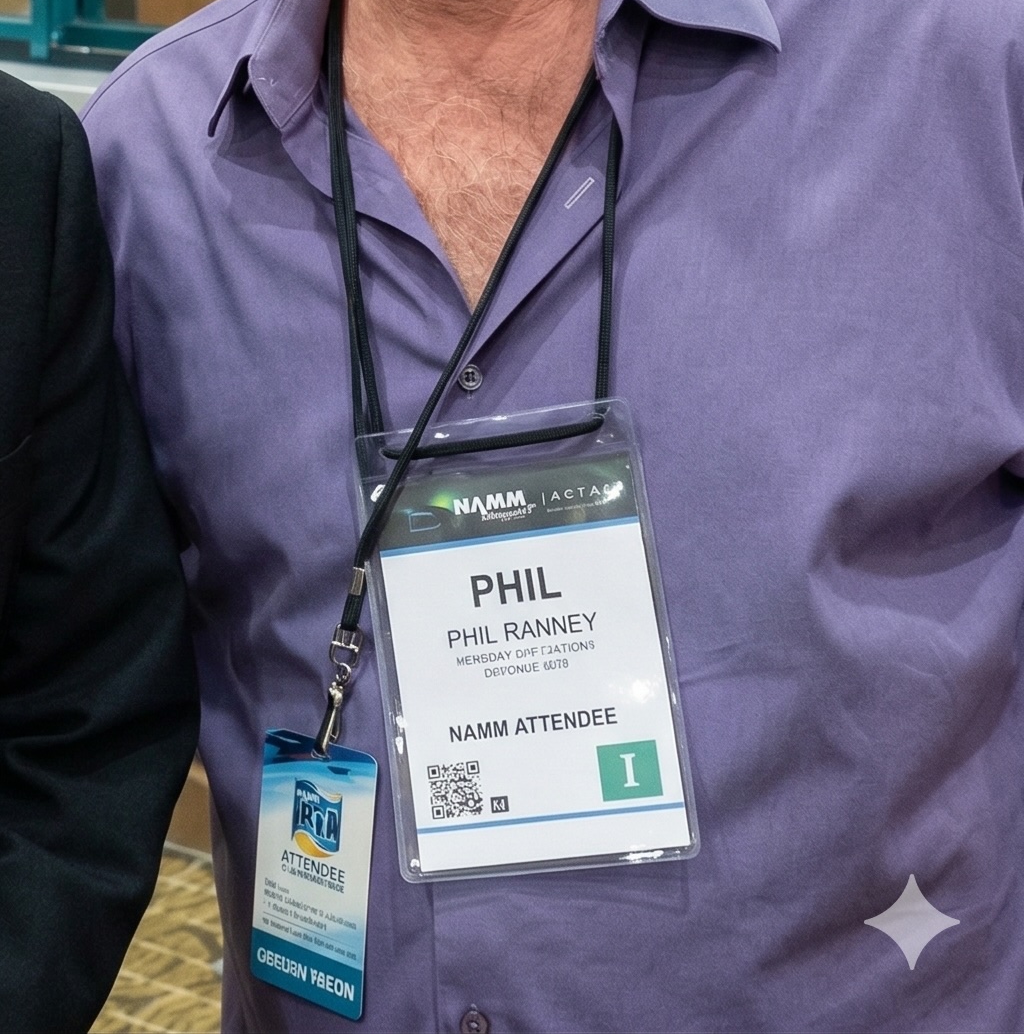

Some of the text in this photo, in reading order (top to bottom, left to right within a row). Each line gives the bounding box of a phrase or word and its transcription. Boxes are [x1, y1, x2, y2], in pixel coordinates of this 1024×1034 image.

[453, 489, 527, 516] NAMM
[470, 566, 562, 608] PHIL
[447, 612, 597, 649] PHIL RANNEY
[449, 707, 618, 743] NAMM ATTENDEE
[620, 753, 640, 788] I
[281, 849, 346, 884] ATTENDEE
